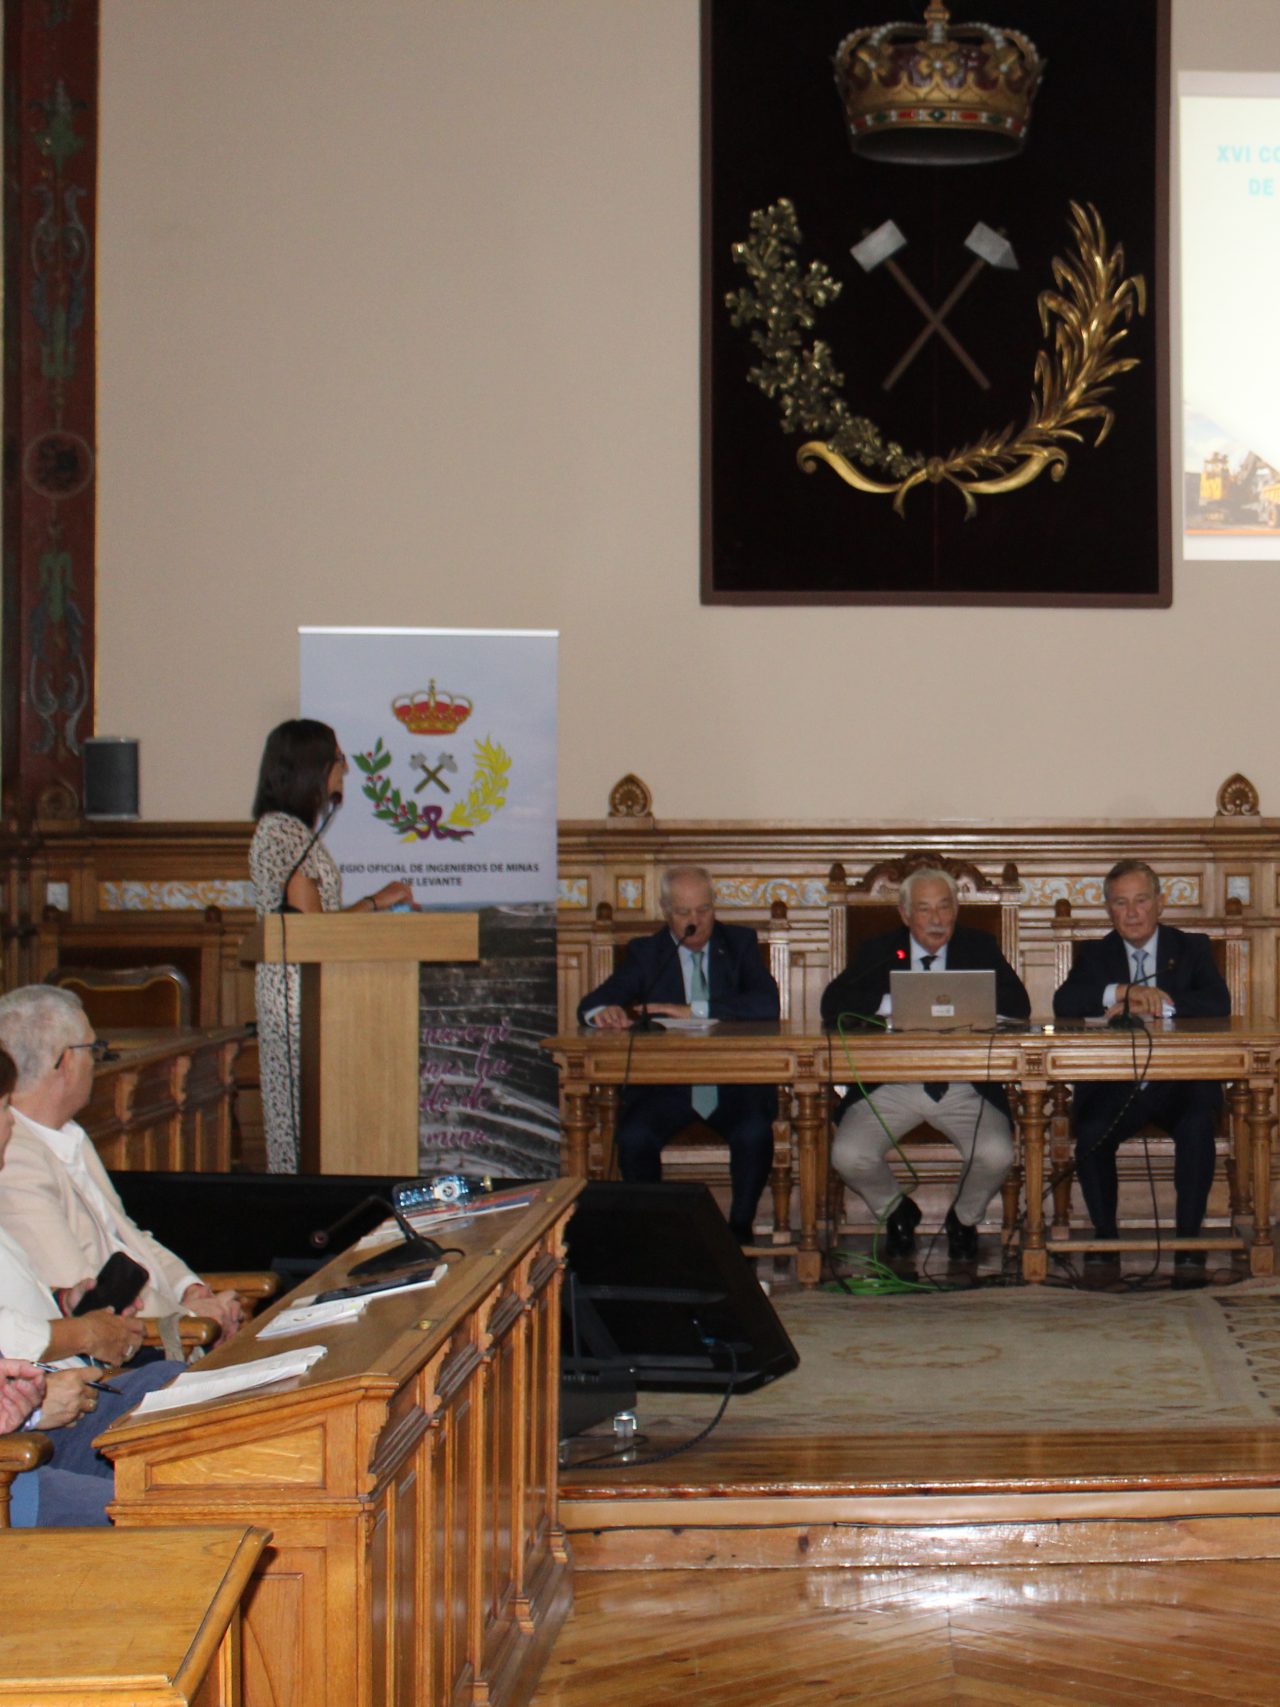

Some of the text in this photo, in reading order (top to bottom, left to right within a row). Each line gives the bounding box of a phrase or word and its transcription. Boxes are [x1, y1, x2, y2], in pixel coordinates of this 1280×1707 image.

[1216, 144, 1252, 164] XVI
[1248, 178, 1274, 197] DE
[340, 863, 540, 874] EGIO OFICIAL DE INGENIEROS DE MINAS
[416, 876, 463, 888] LEVANTE
